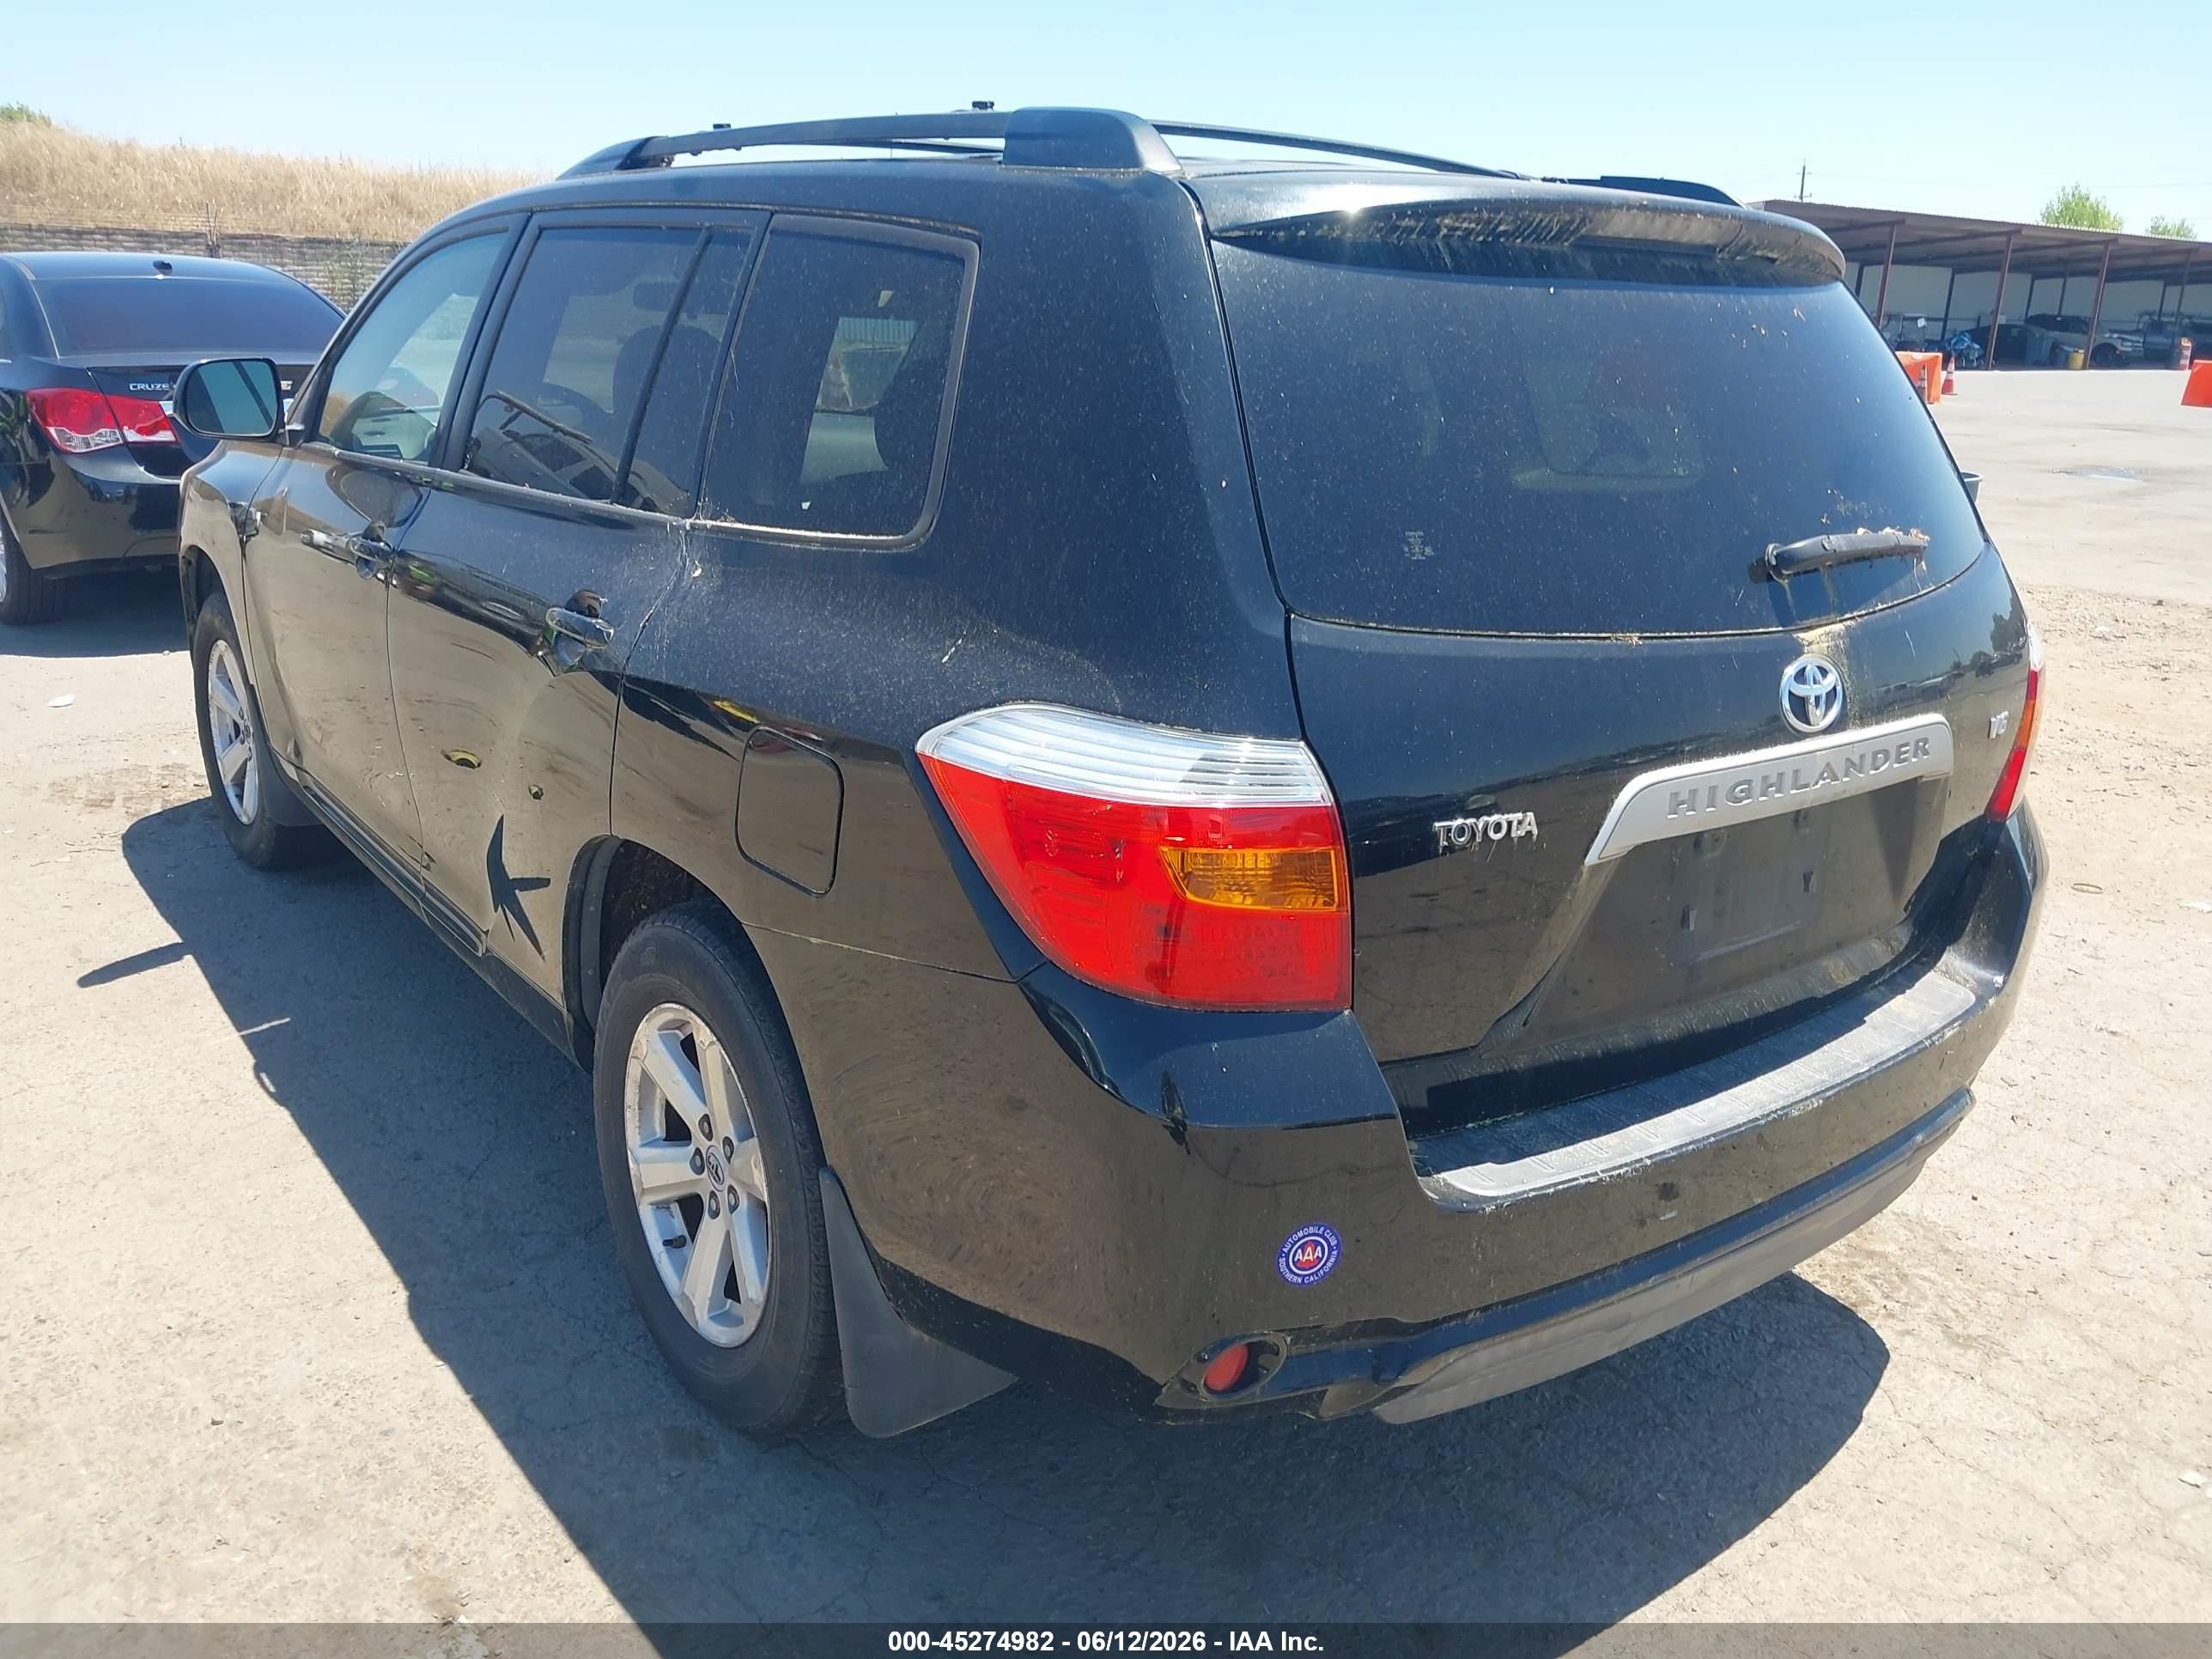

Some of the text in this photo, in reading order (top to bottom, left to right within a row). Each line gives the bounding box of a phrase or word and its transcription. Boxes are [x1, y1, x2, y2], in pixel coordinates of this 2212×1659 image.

[129, 383, 170, 392] CRUZE
[1667, 737, 1931, 820] HIGHLANDER
[1433, 811, 1539, 847] TOYOTA
[1282, 1225, 1337, 1254] AUTOMOBILE CLUB
[1294, 1245, 1322, 1262] AAA
[1279, 1249, 1338, 1285] SOUTHERN CALIFORNIA
